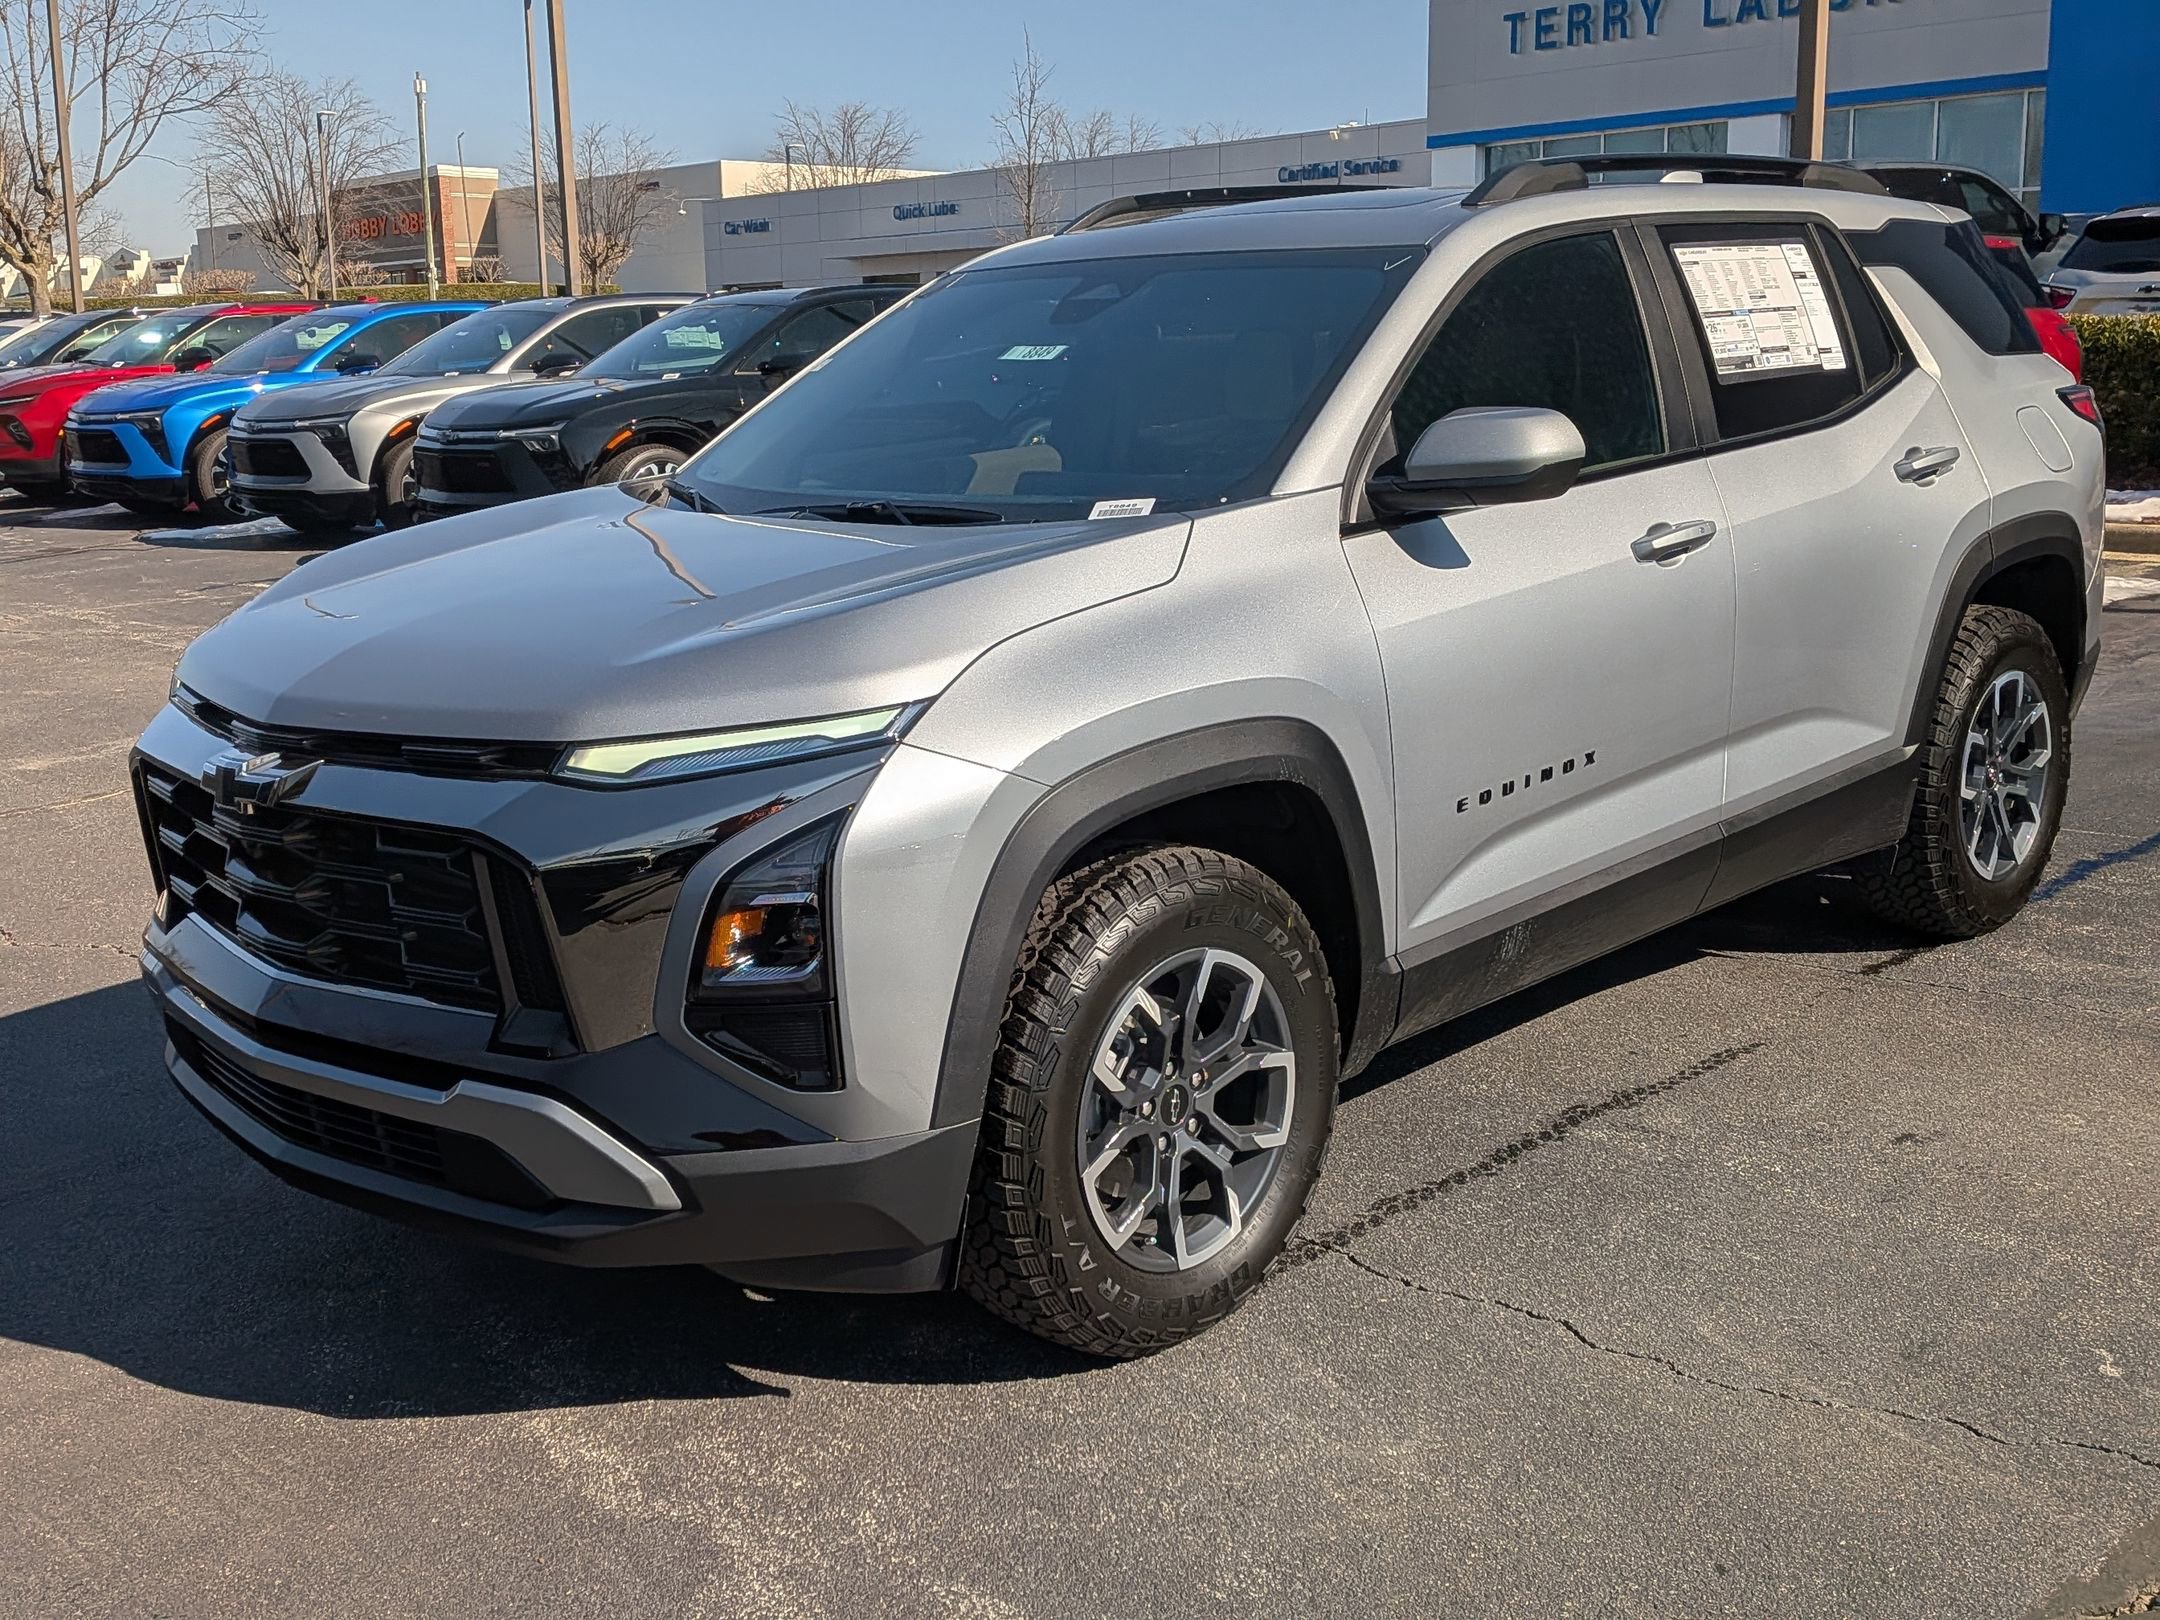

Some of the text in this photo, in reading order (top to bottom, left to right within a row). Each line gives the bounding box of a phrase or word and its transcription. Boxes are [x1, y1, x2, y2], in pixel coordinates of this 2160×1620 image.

[1503, 0, 1663, 54] TERRY
[1278, 156, 1399, 182] Certified Service
[724, 219, 770, 235] Car Wash
[893, 201, 959, 221] Quick Lube
[1456, 750, 1596, 813] EQUINOX
[1183, 904, 1312, 996] GENERAL
[1061, 1214, 1098, 1272] A/T
